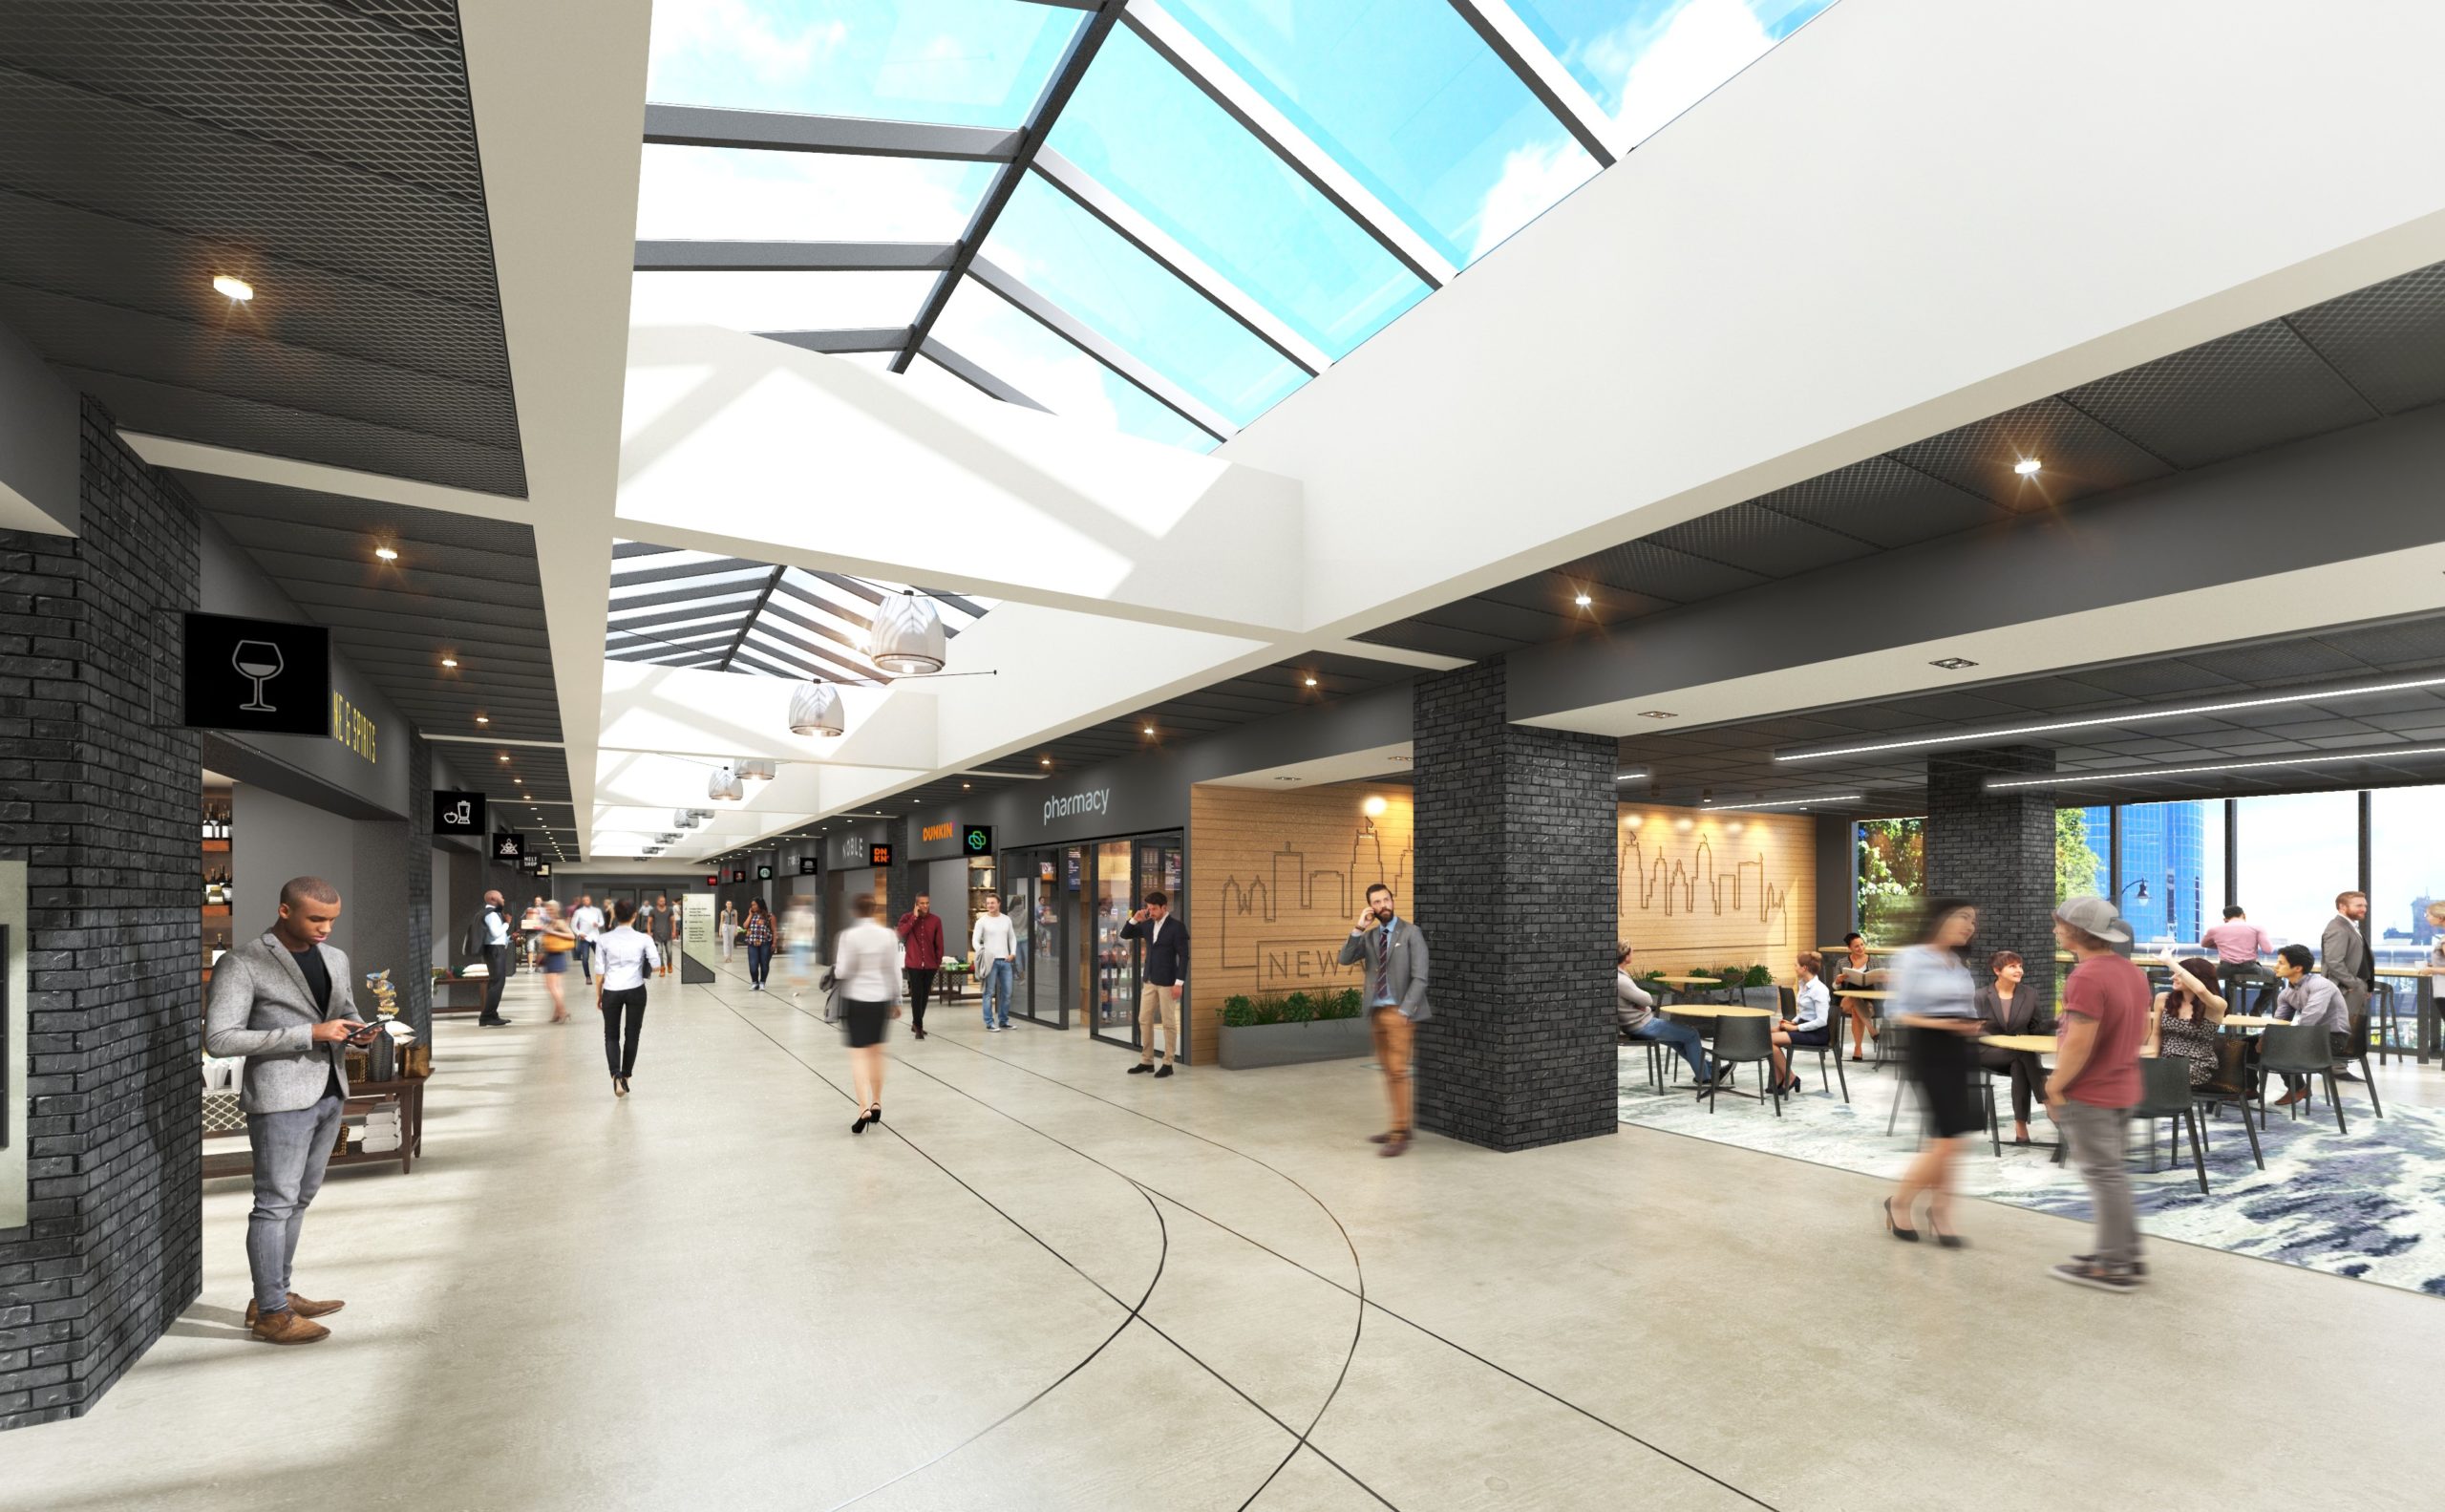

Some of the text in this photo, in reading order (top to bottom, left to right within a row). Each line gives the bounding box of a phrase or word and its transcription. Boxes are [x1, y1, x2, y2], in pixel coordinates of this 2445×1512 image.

[353, 707, 376, 764] SPIRITS
[1043, 787, 1110, 826] pharmacy
[874, 847, 887, 856] DN
